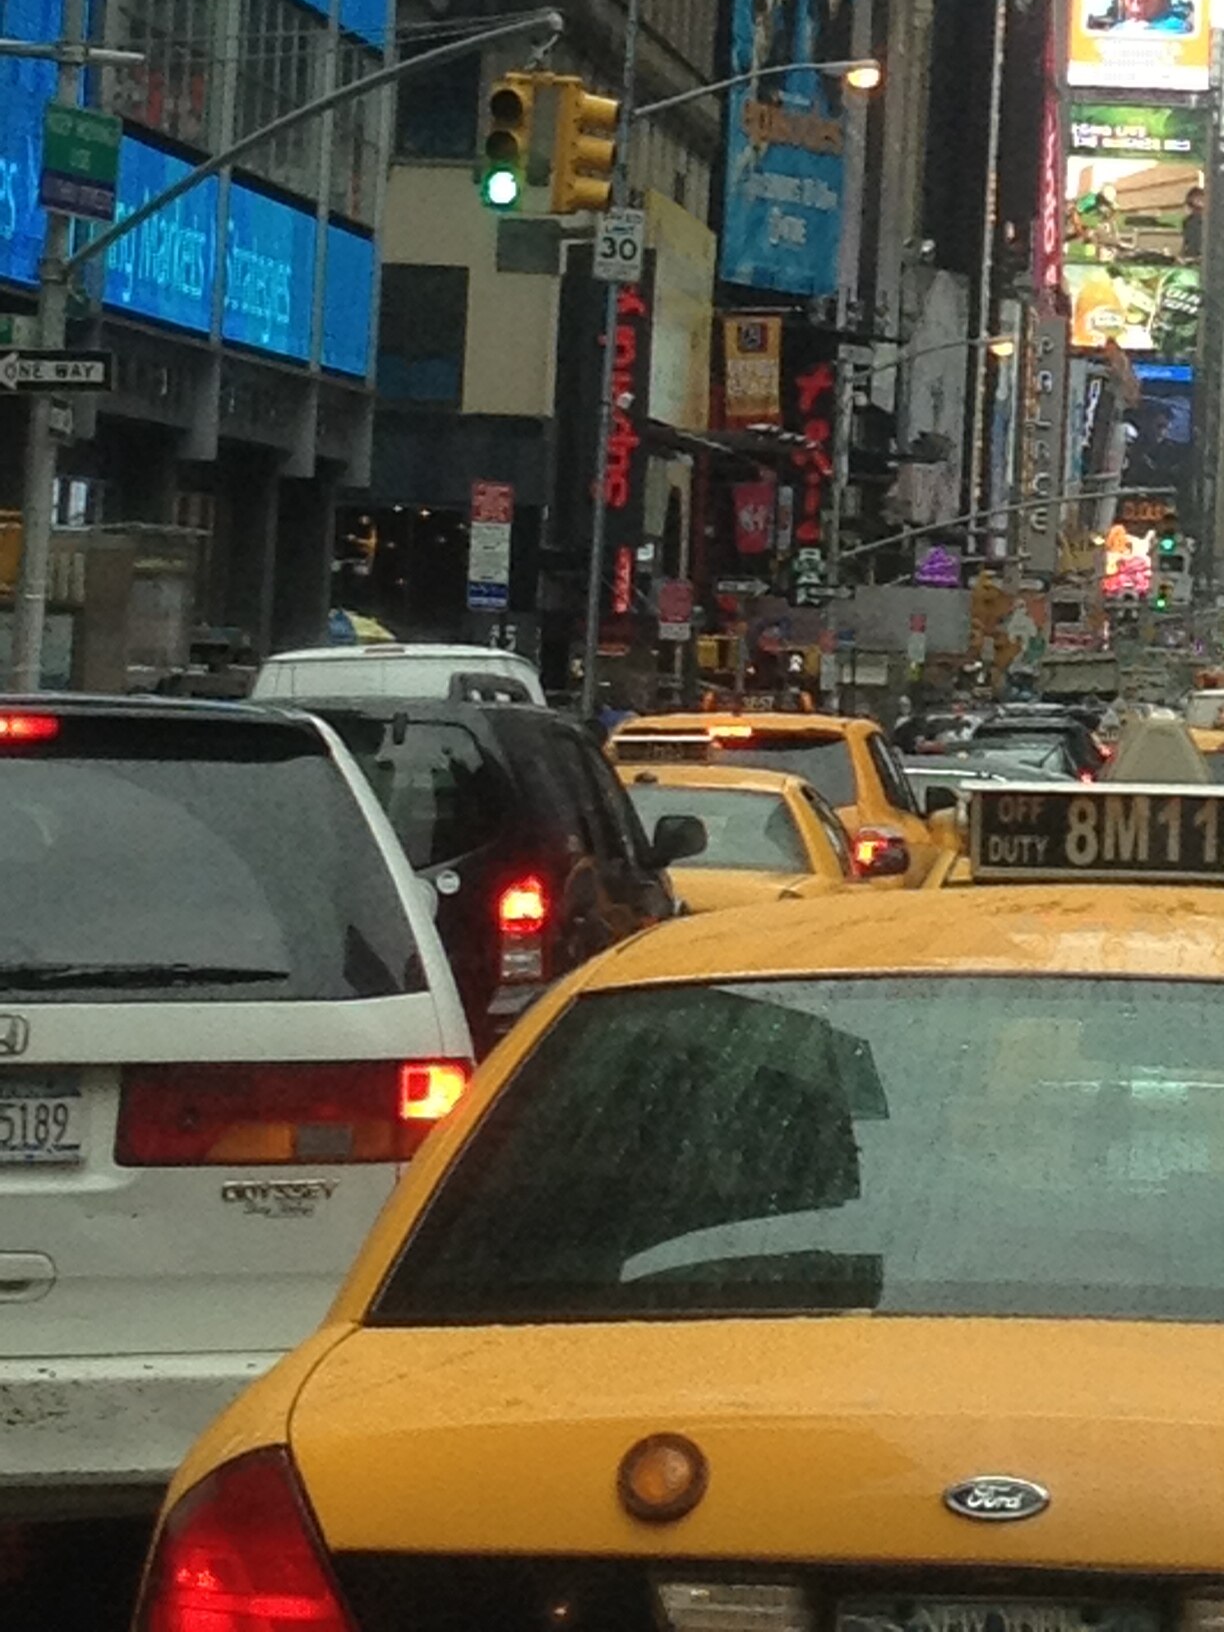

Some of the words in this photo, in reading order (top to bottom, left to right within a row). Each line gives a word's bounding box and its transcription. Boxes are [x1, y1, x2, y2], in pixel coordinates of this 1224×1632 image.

[600, 235, 638, 261] 30
[55, 363, 96, 380] WAY
[999, 796, 1045, 825] OFF
[1064, 795, 1219, 867] 8M11
[988, 834, 1050, 864] DUTY
[0, 1102, 69, 1149] 5189
[221, 1177, 341, 1204] ODYSSEY
[964, 1482, 1025, 1512] Ford
